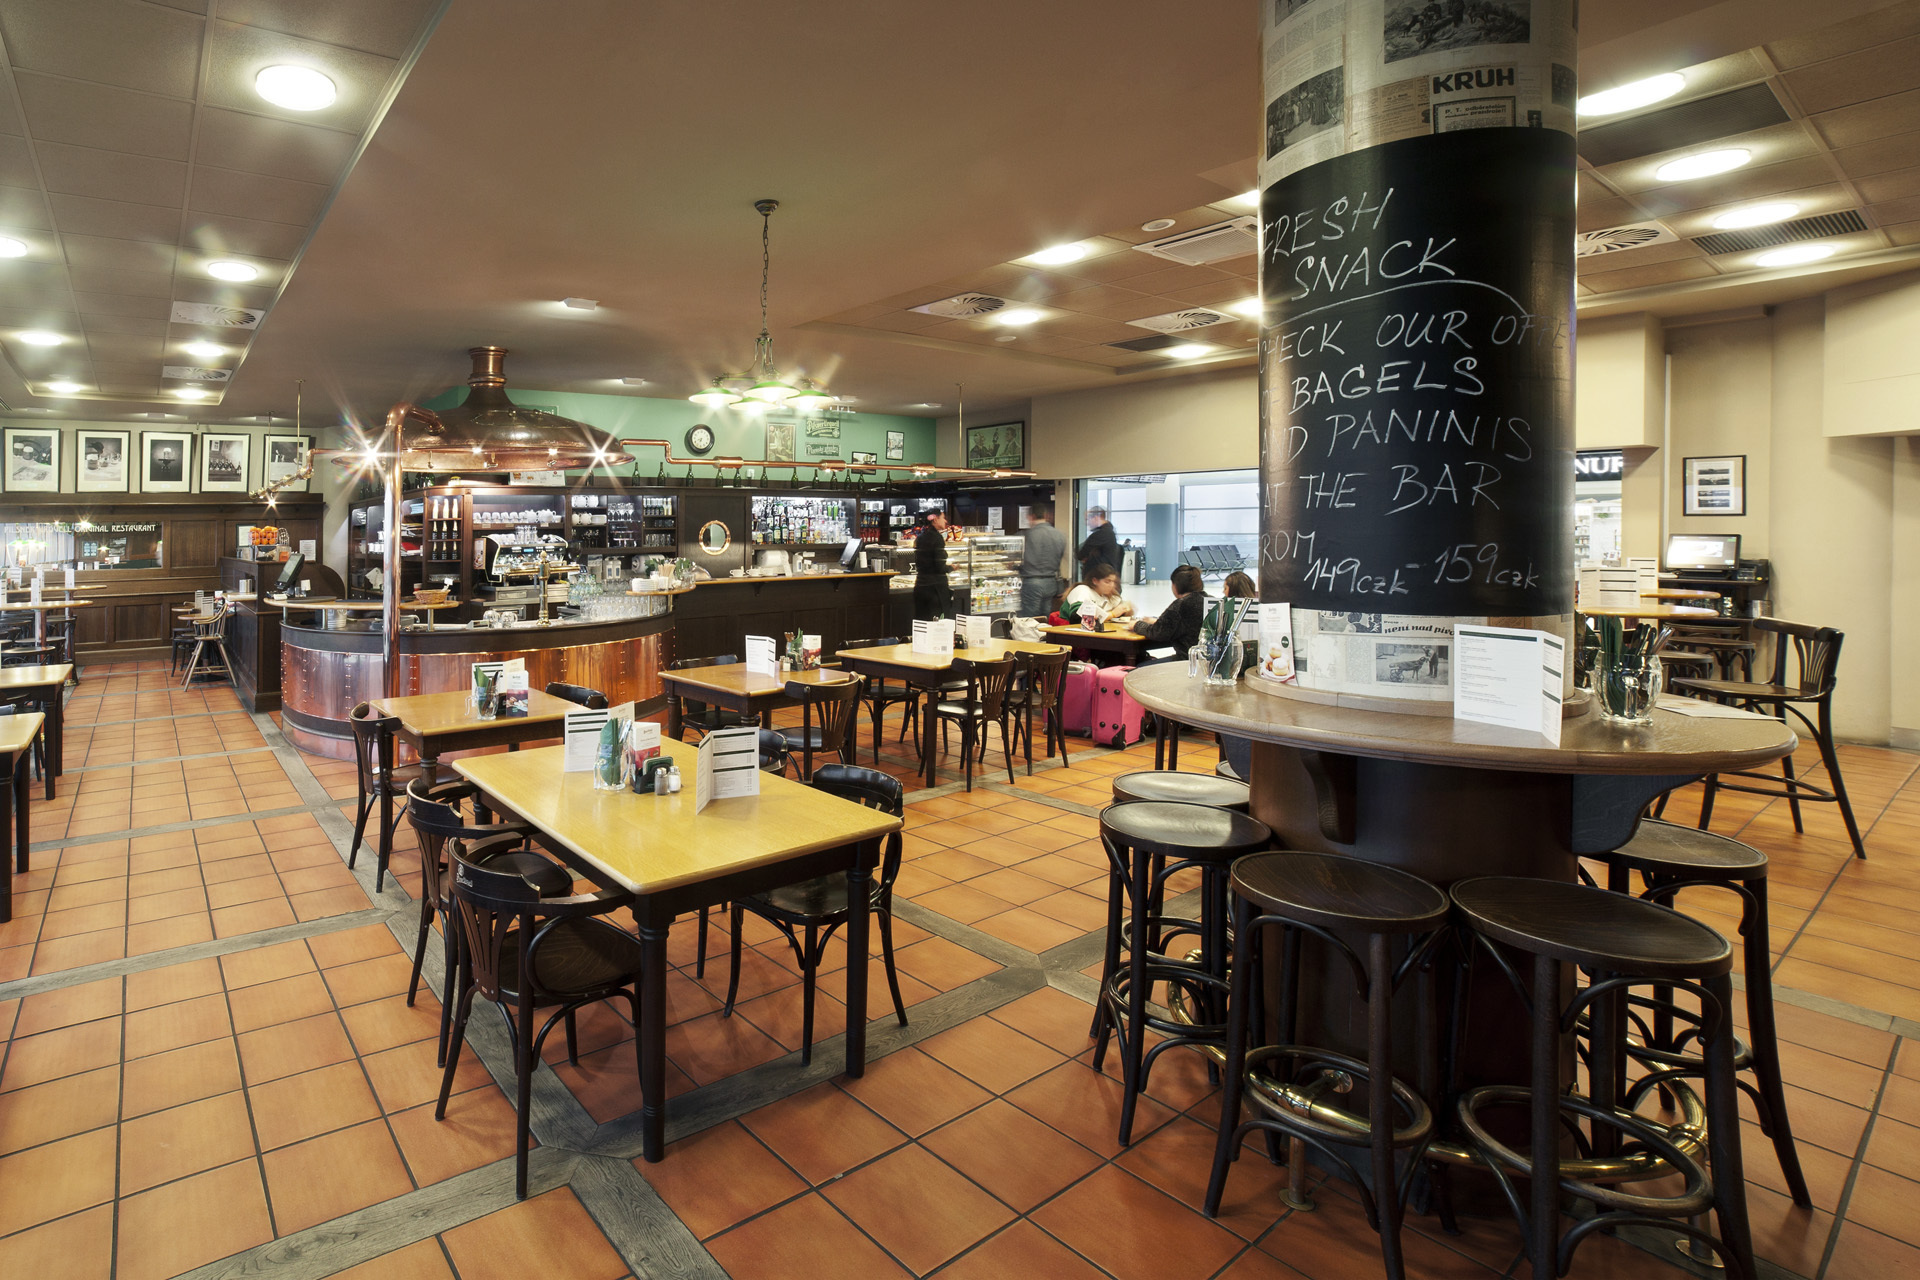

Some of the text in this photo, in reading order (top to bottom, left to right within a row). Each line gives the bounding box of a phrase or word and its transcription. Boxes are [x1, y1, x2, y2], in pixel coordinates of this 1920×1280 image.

[1433, 67, 1515, 95] KRUH
[1262, 187, 1394, 264] FRESH
[1291, 237, 1456, 301] SNACK
[1260, 310, 1574, 374] CHECK OUR OFFE
[1288, 356, 1484, 416] BAGELS
[1261, 409, 1532, 466] AND PANINIS
[1263, 461, 1502, 521] AT THE BAR
[111, 524, 156, 532] RESTAURANT
[1411, 624, 1433, 632] nad
